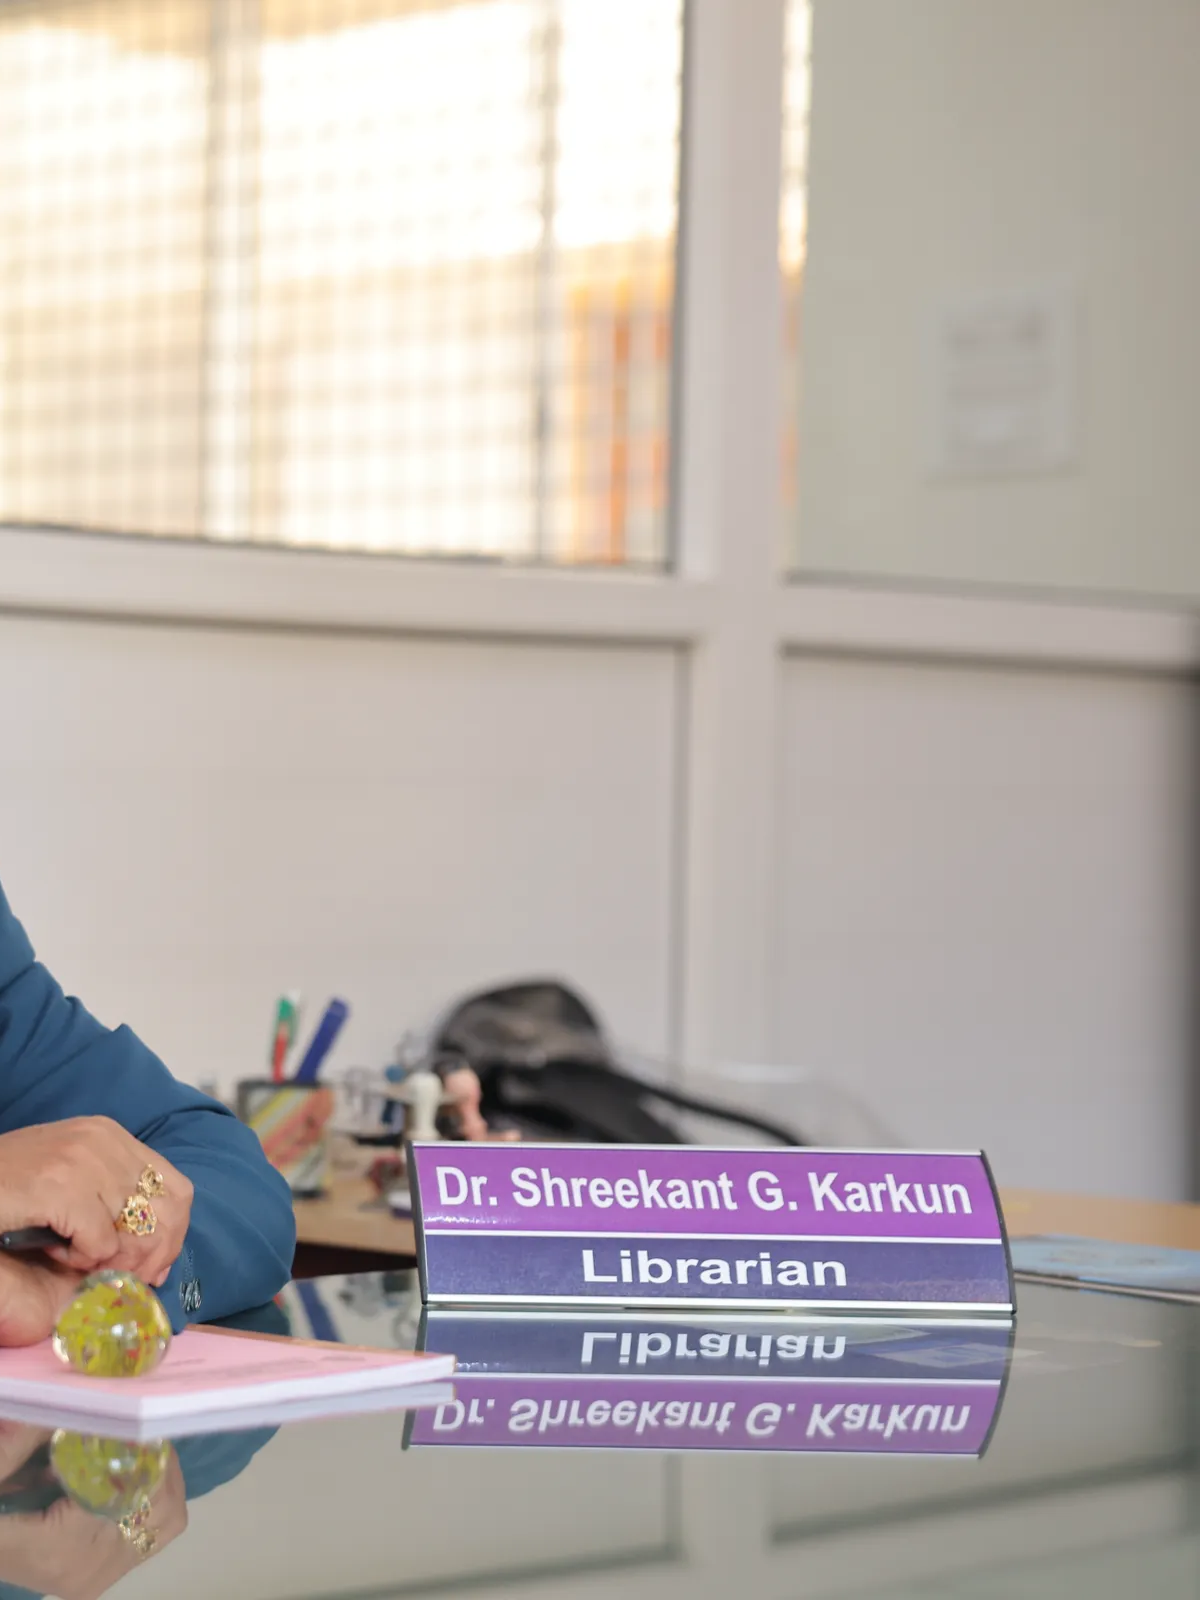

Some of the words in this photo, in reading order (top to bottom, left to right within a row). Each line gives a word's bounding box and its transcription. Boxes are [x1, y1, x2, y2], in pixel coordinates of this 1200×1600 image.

[435, 1166, 498, 1207] Dr.
[510, 1166, 739, 1211] Shreekant
[747, 1170, 798, 1212] G.
[807, 1171, 973, 1215] Karkun
[582, 1249, 847, 1287] Librarian
